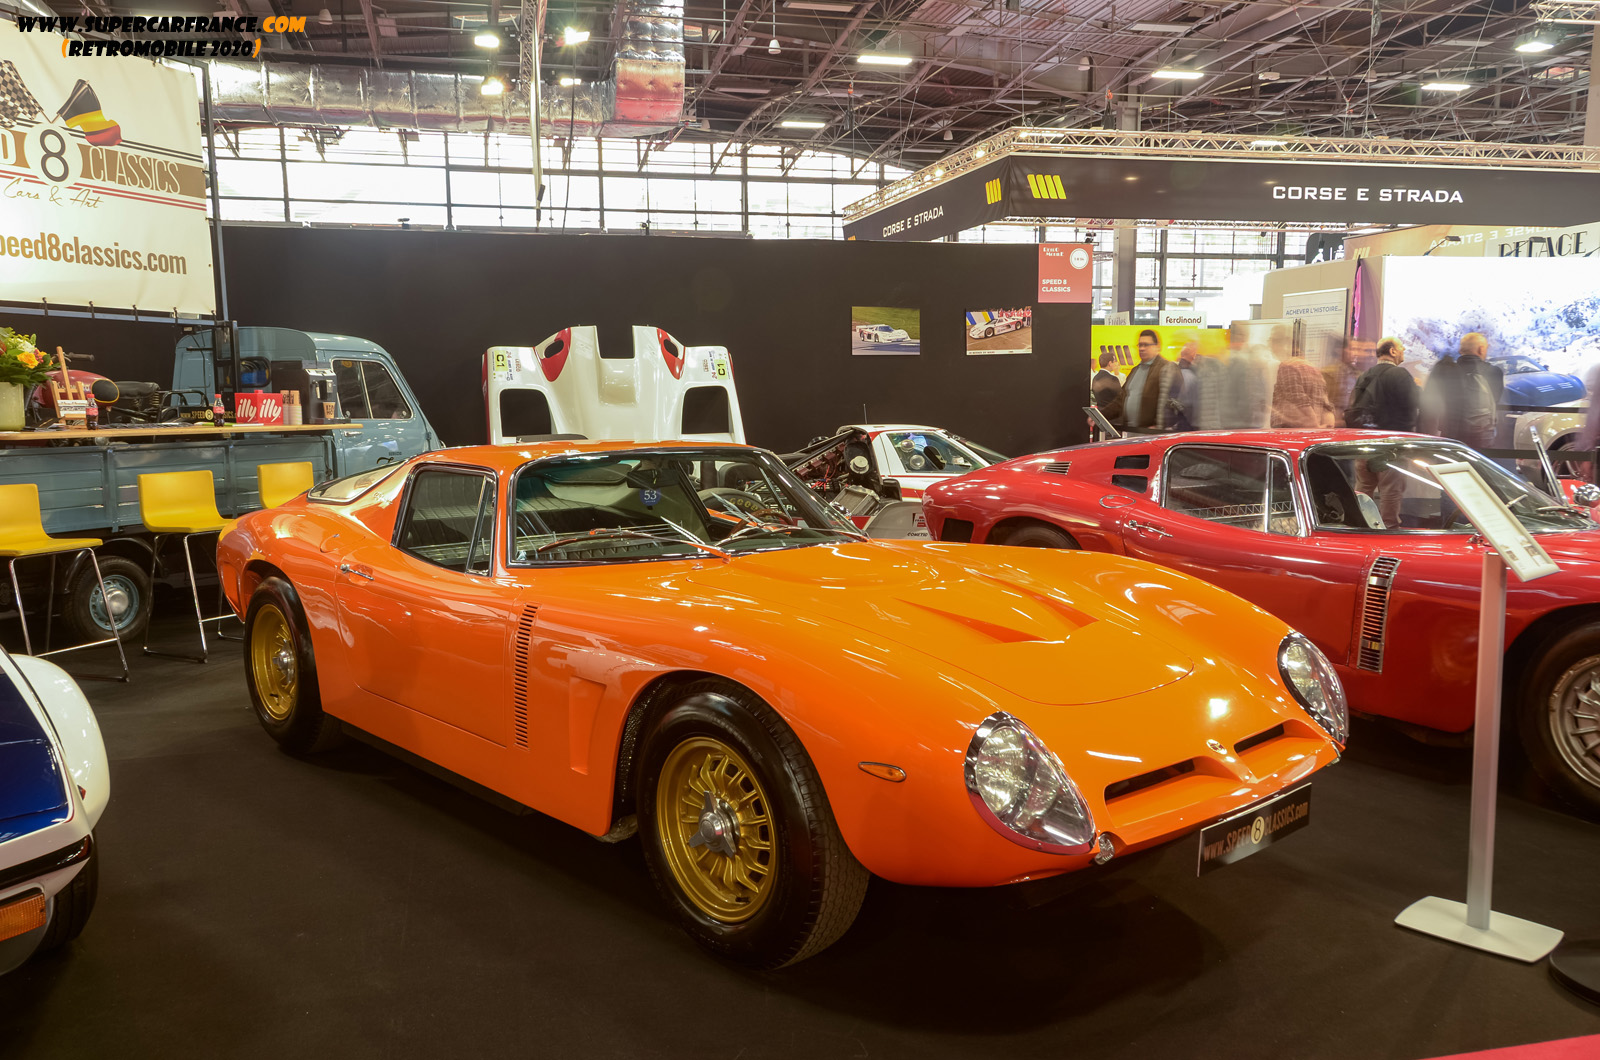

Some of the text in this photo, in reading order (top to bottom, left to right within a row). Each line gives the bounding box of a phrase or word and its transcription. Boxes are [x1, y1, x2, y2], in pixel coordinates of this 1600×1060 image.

[89, 146, 180, 195] CLASSICS
[3, 177, 105, 209] Cars & Art
[1273, 185, 1464, 204] CORSE E STRADA
[882, 205, 944, 238] CORSE E STRADA
[237, 398, 257, 422] illy
[259, 398, 282, 422] illy
[644, 490, 657, 500] 53
